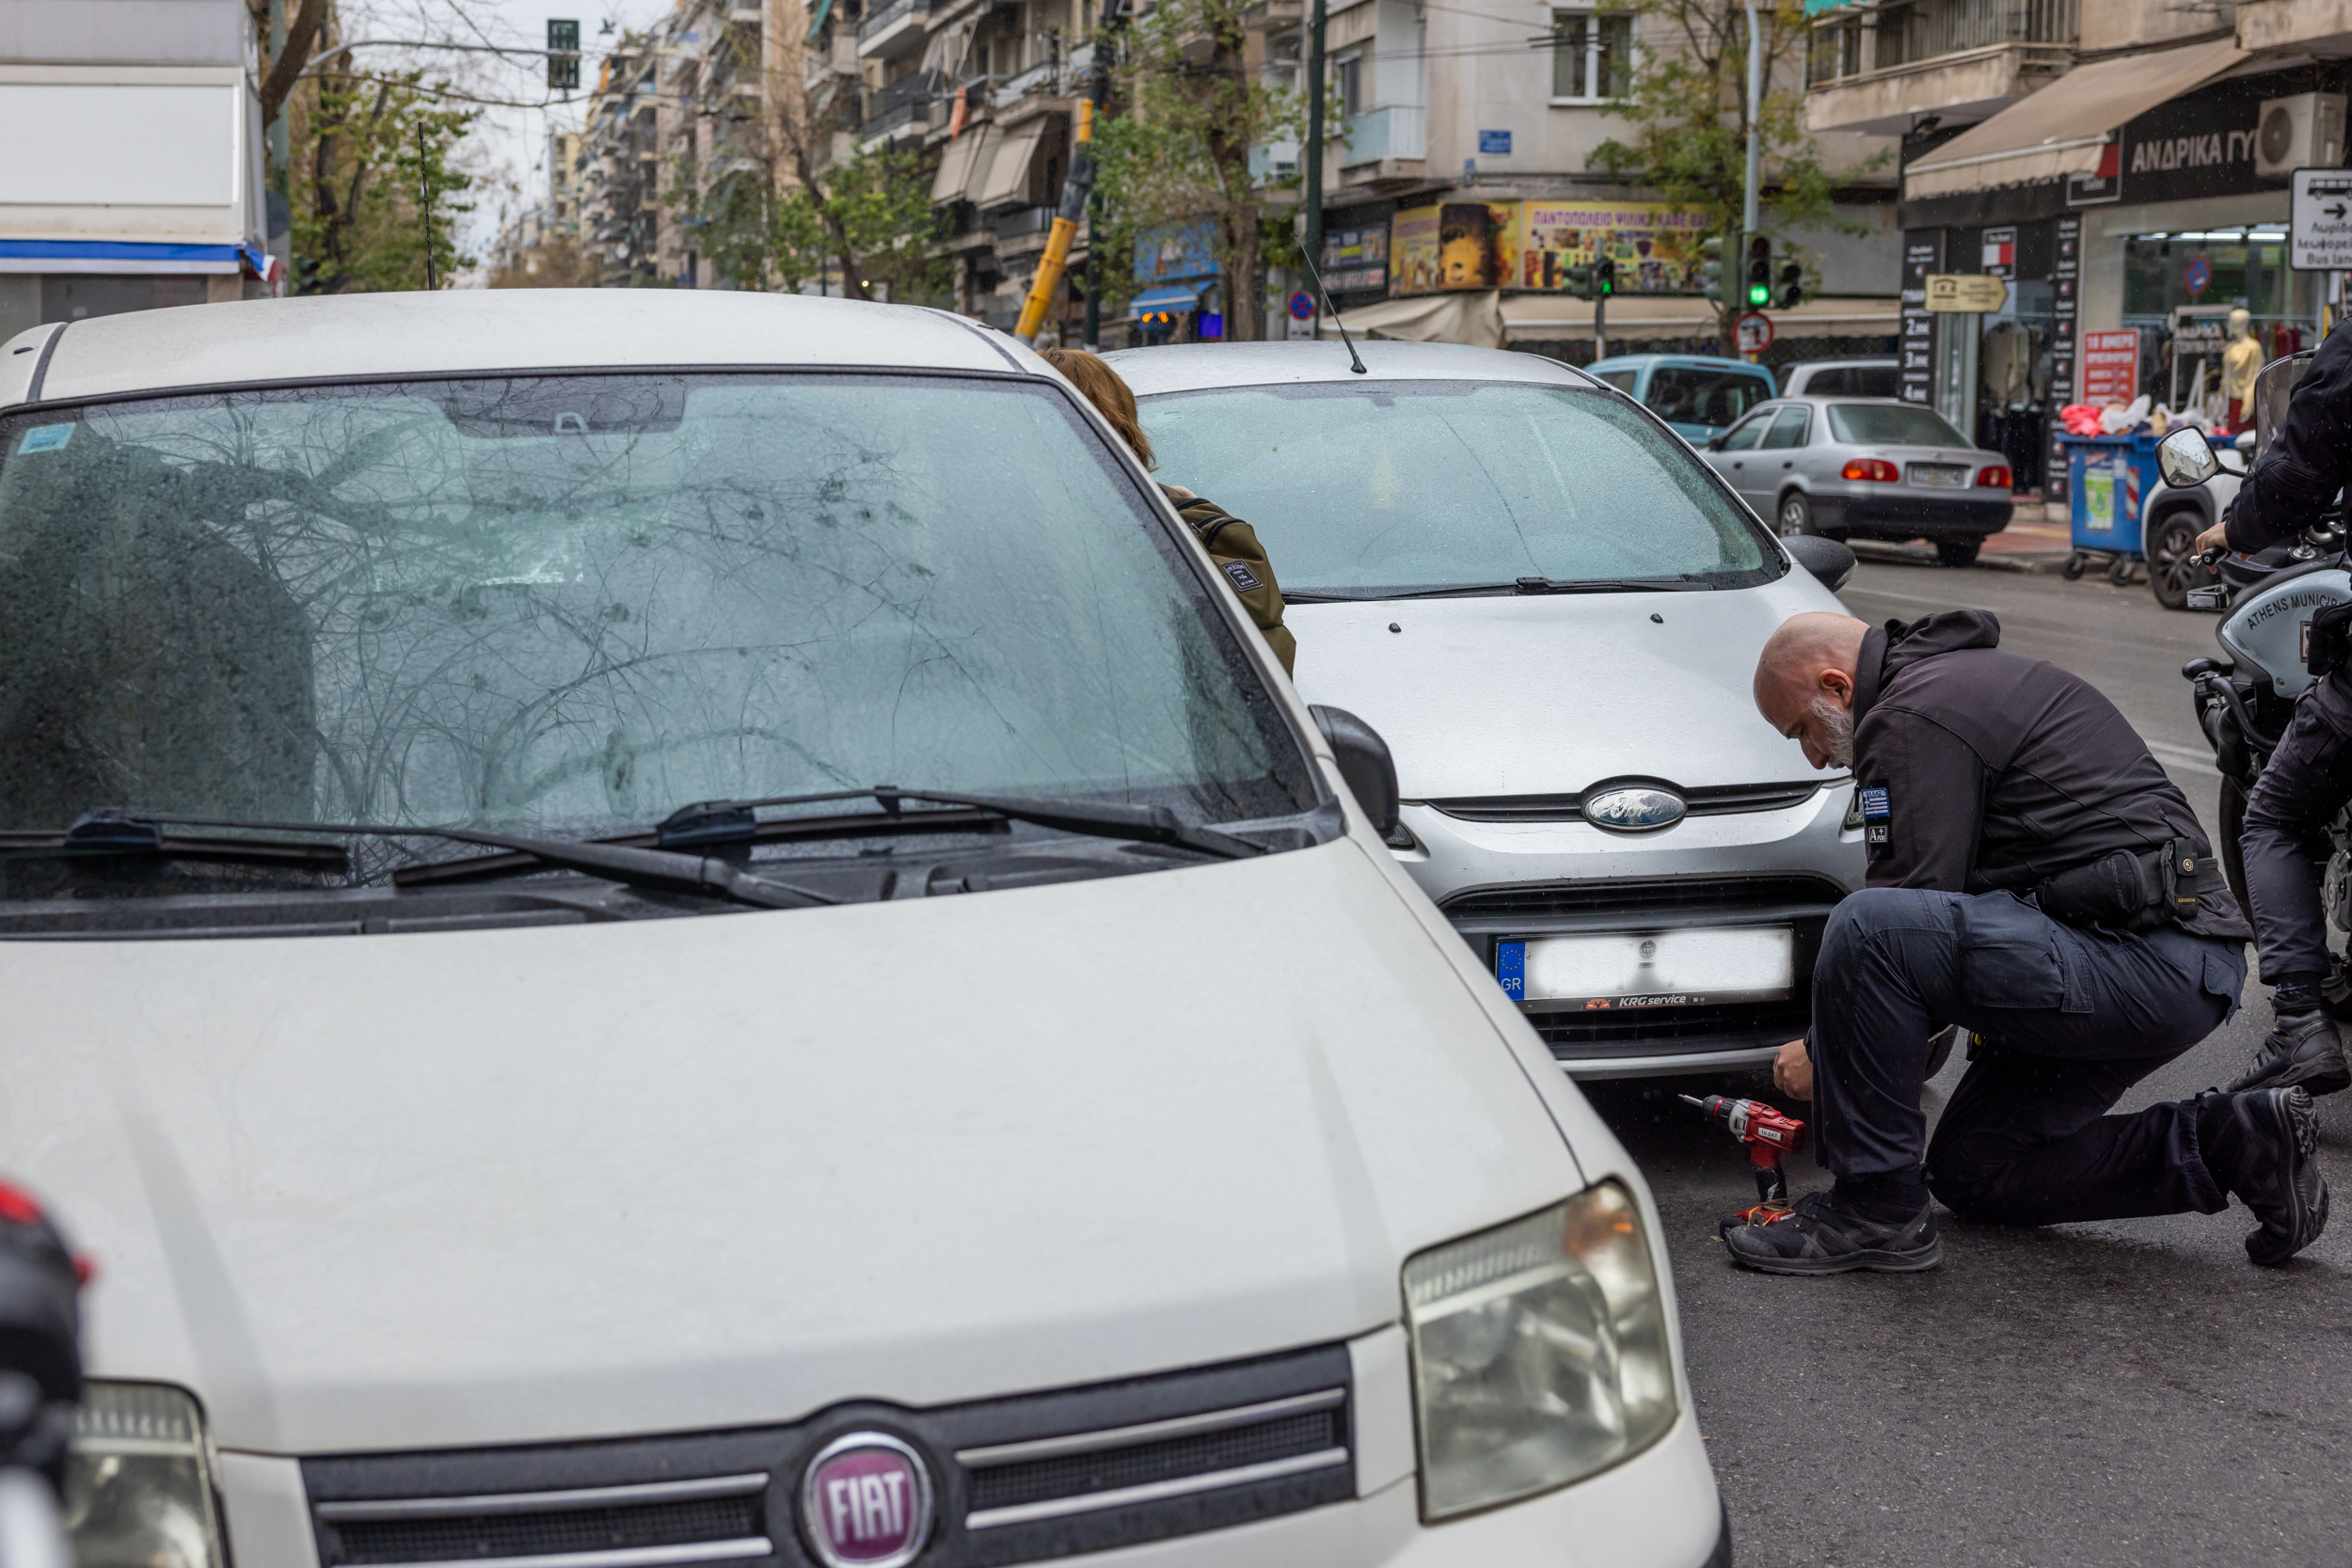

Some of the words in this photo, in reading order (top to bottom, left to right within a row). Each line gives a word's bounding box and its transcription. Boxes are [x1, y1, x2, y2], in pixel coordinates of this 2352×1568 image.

[2131, 133, 2223, 174] ΑΝΔΡΙΚΑ
[2227, 128, 2260, 163] ΓΥ
[2307, 252, 2328, 264] Bus
[2332, 252, 2352, 264] lan
[2247, 597, 2289, 630] ATHENS
[2290, 593, 2342, 609] MUNICIP
[1501, 977, 1521, 991] GR
[1619, 996, 1647, 1006] KRG
[1647, 994, 1687, 1006] service
[827, 1470, 905, 1544] FIAT
